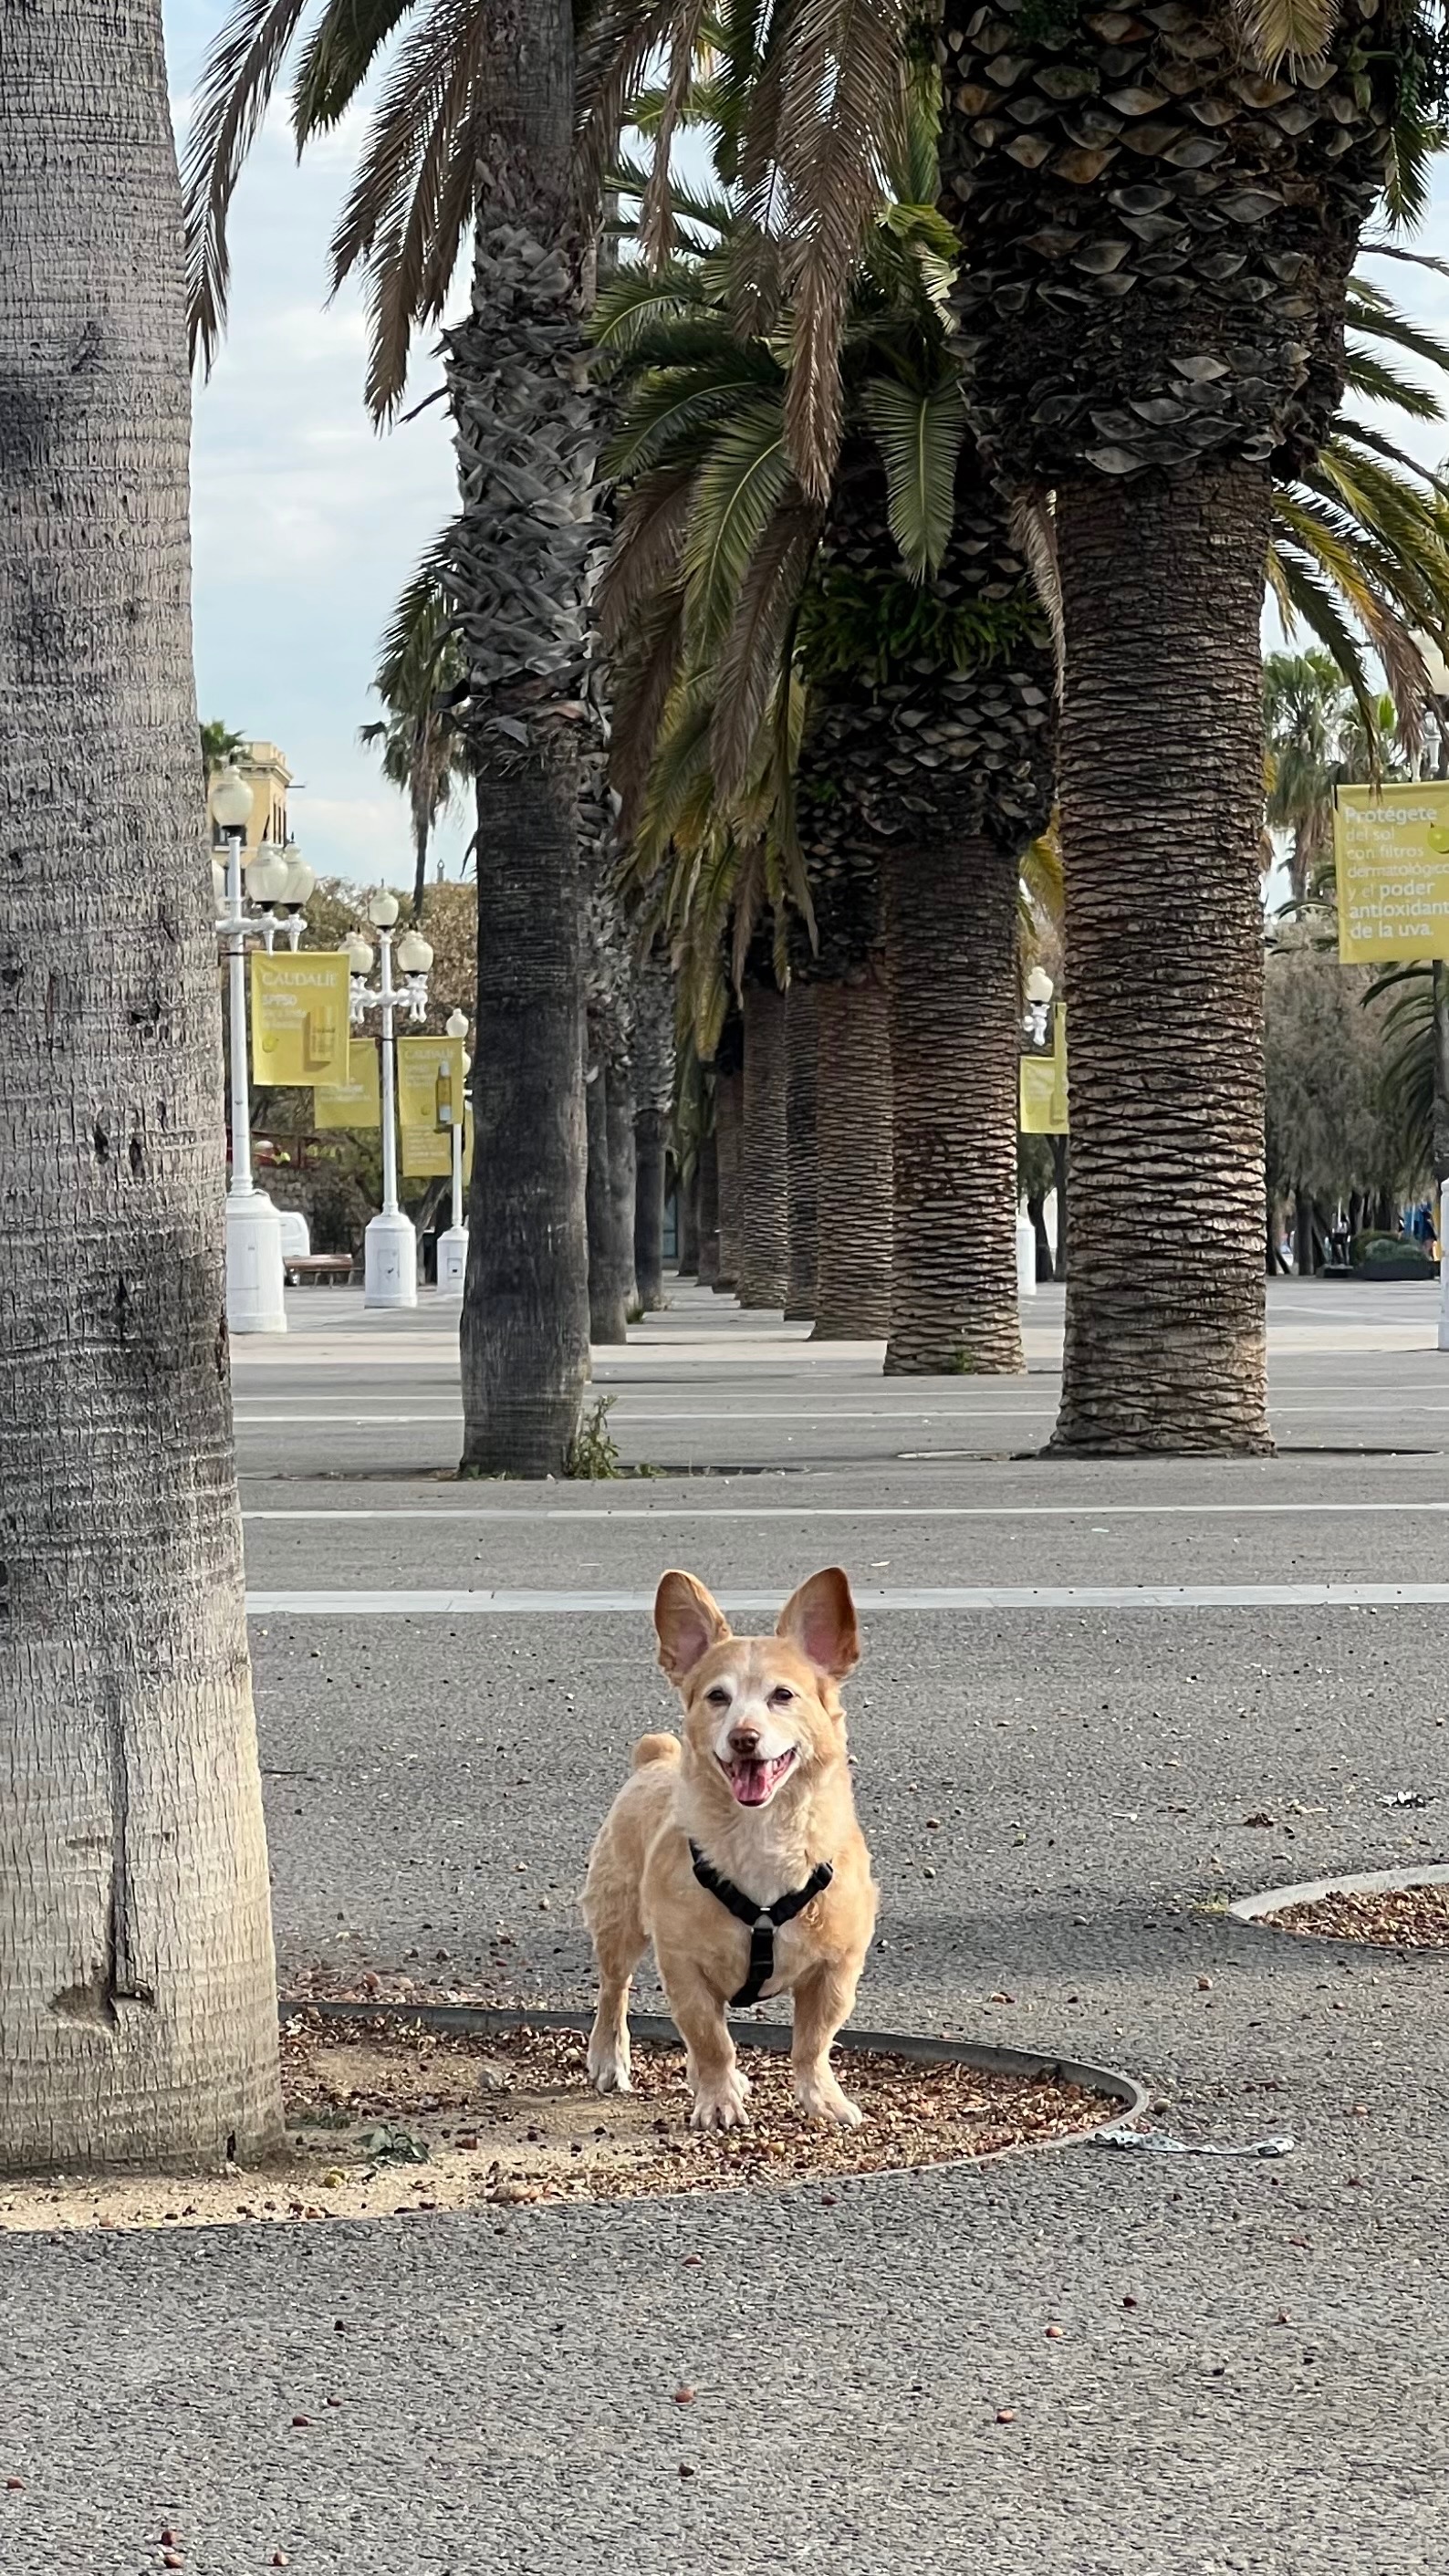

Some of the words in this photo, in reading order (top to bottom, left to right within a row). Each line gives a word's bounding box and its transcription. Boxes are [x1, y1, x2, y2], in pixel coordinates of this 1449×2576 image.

[1345, 805, 1437, 826] Protégete
[1346, 826, 1368, 841] del
[1372, 825, 1394, 841] sol
[1347, 849, 1374, 860] con
[1381, 844, 1424, 859] filtros
[1348, 887, 1357, 902] y
[1361, 883, 1373, 899] el
[1380, 879, 1435, 902] poder
[1350, 921, 1372, 940] de
[1379, 920, 1393, 938] la
[1399, 923, 1434, 938] uva.
